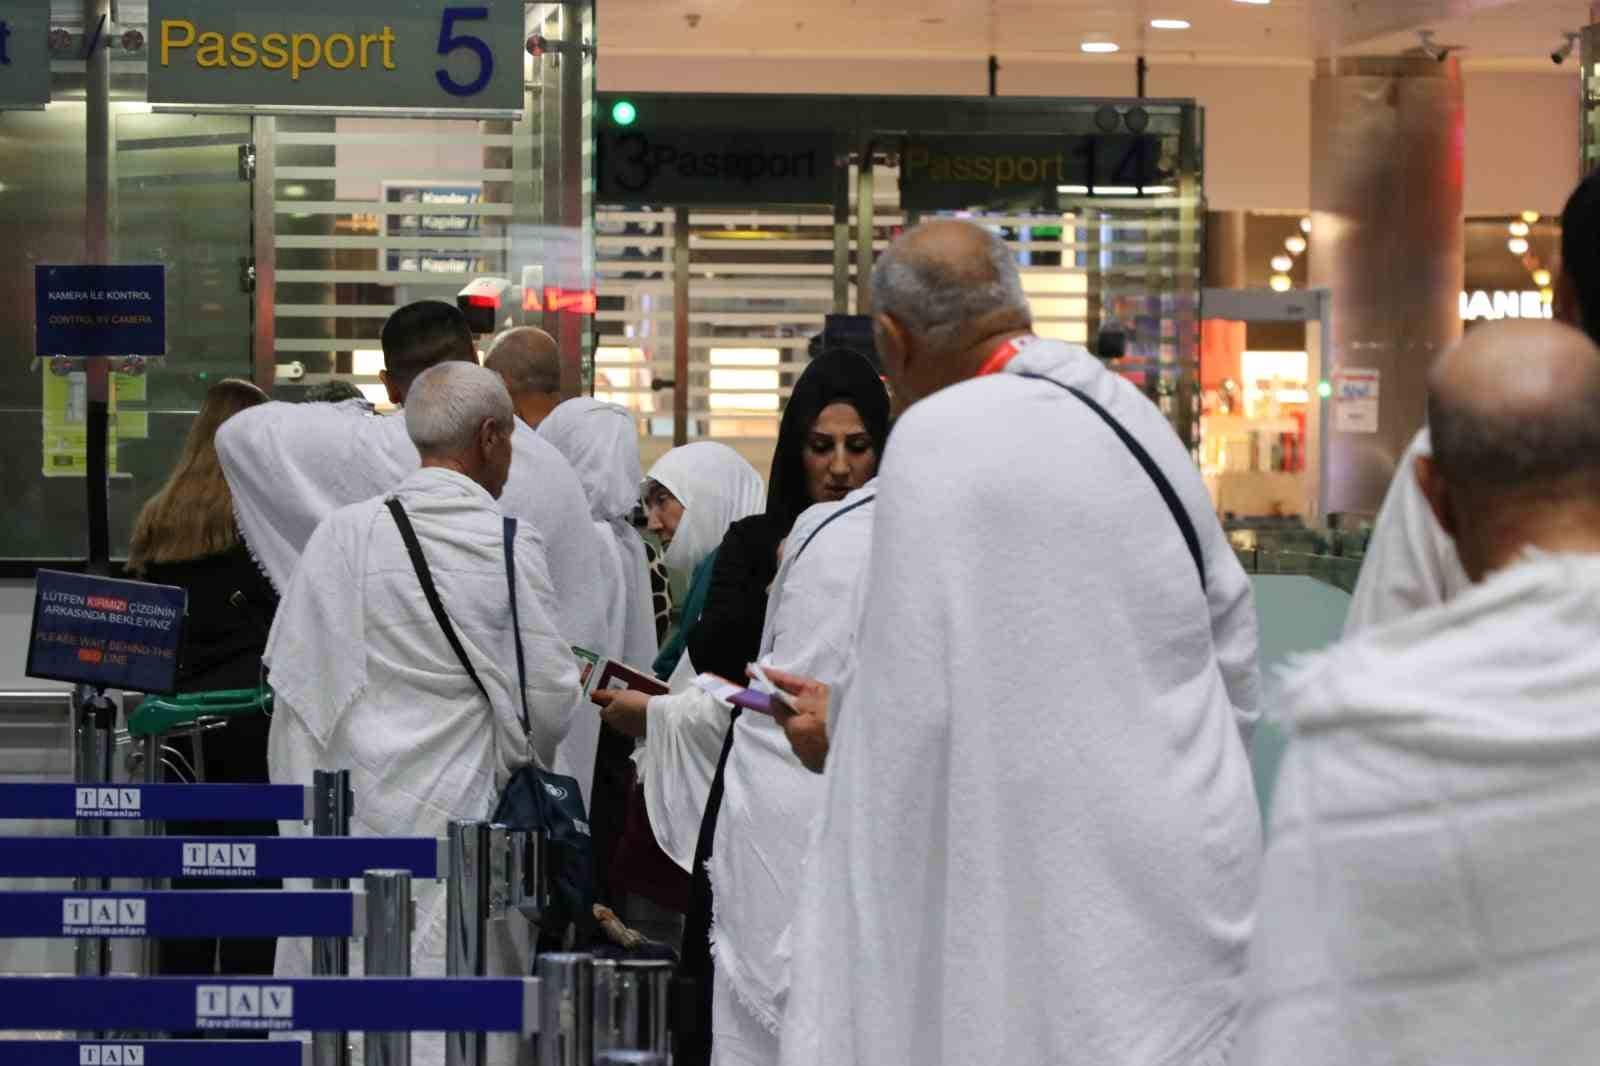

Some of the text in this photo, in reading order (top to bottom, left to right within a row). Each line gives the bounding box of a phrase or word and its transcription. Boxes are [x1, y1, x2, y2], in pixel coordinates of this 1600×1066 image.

[160, 18, 396, 80] Passport
[434, 6, 494, 98] 5
[905, 146, 1066, 188] Passport
[48, 290, 89, 301] KAMERA
[106, 290, 152, 301] KONTROL
[42, 590, 86, 605] LÜTFEN
[44, 605, 106, 622] ARKASINDA
[79, 790, 137, 807] TAV
[186, 846, 252, 864] TAV
[66, 901, 142, 922] TAV
[200, 989, 288, 1013] TAV
[82, 1047, 141, 1064] TAV
